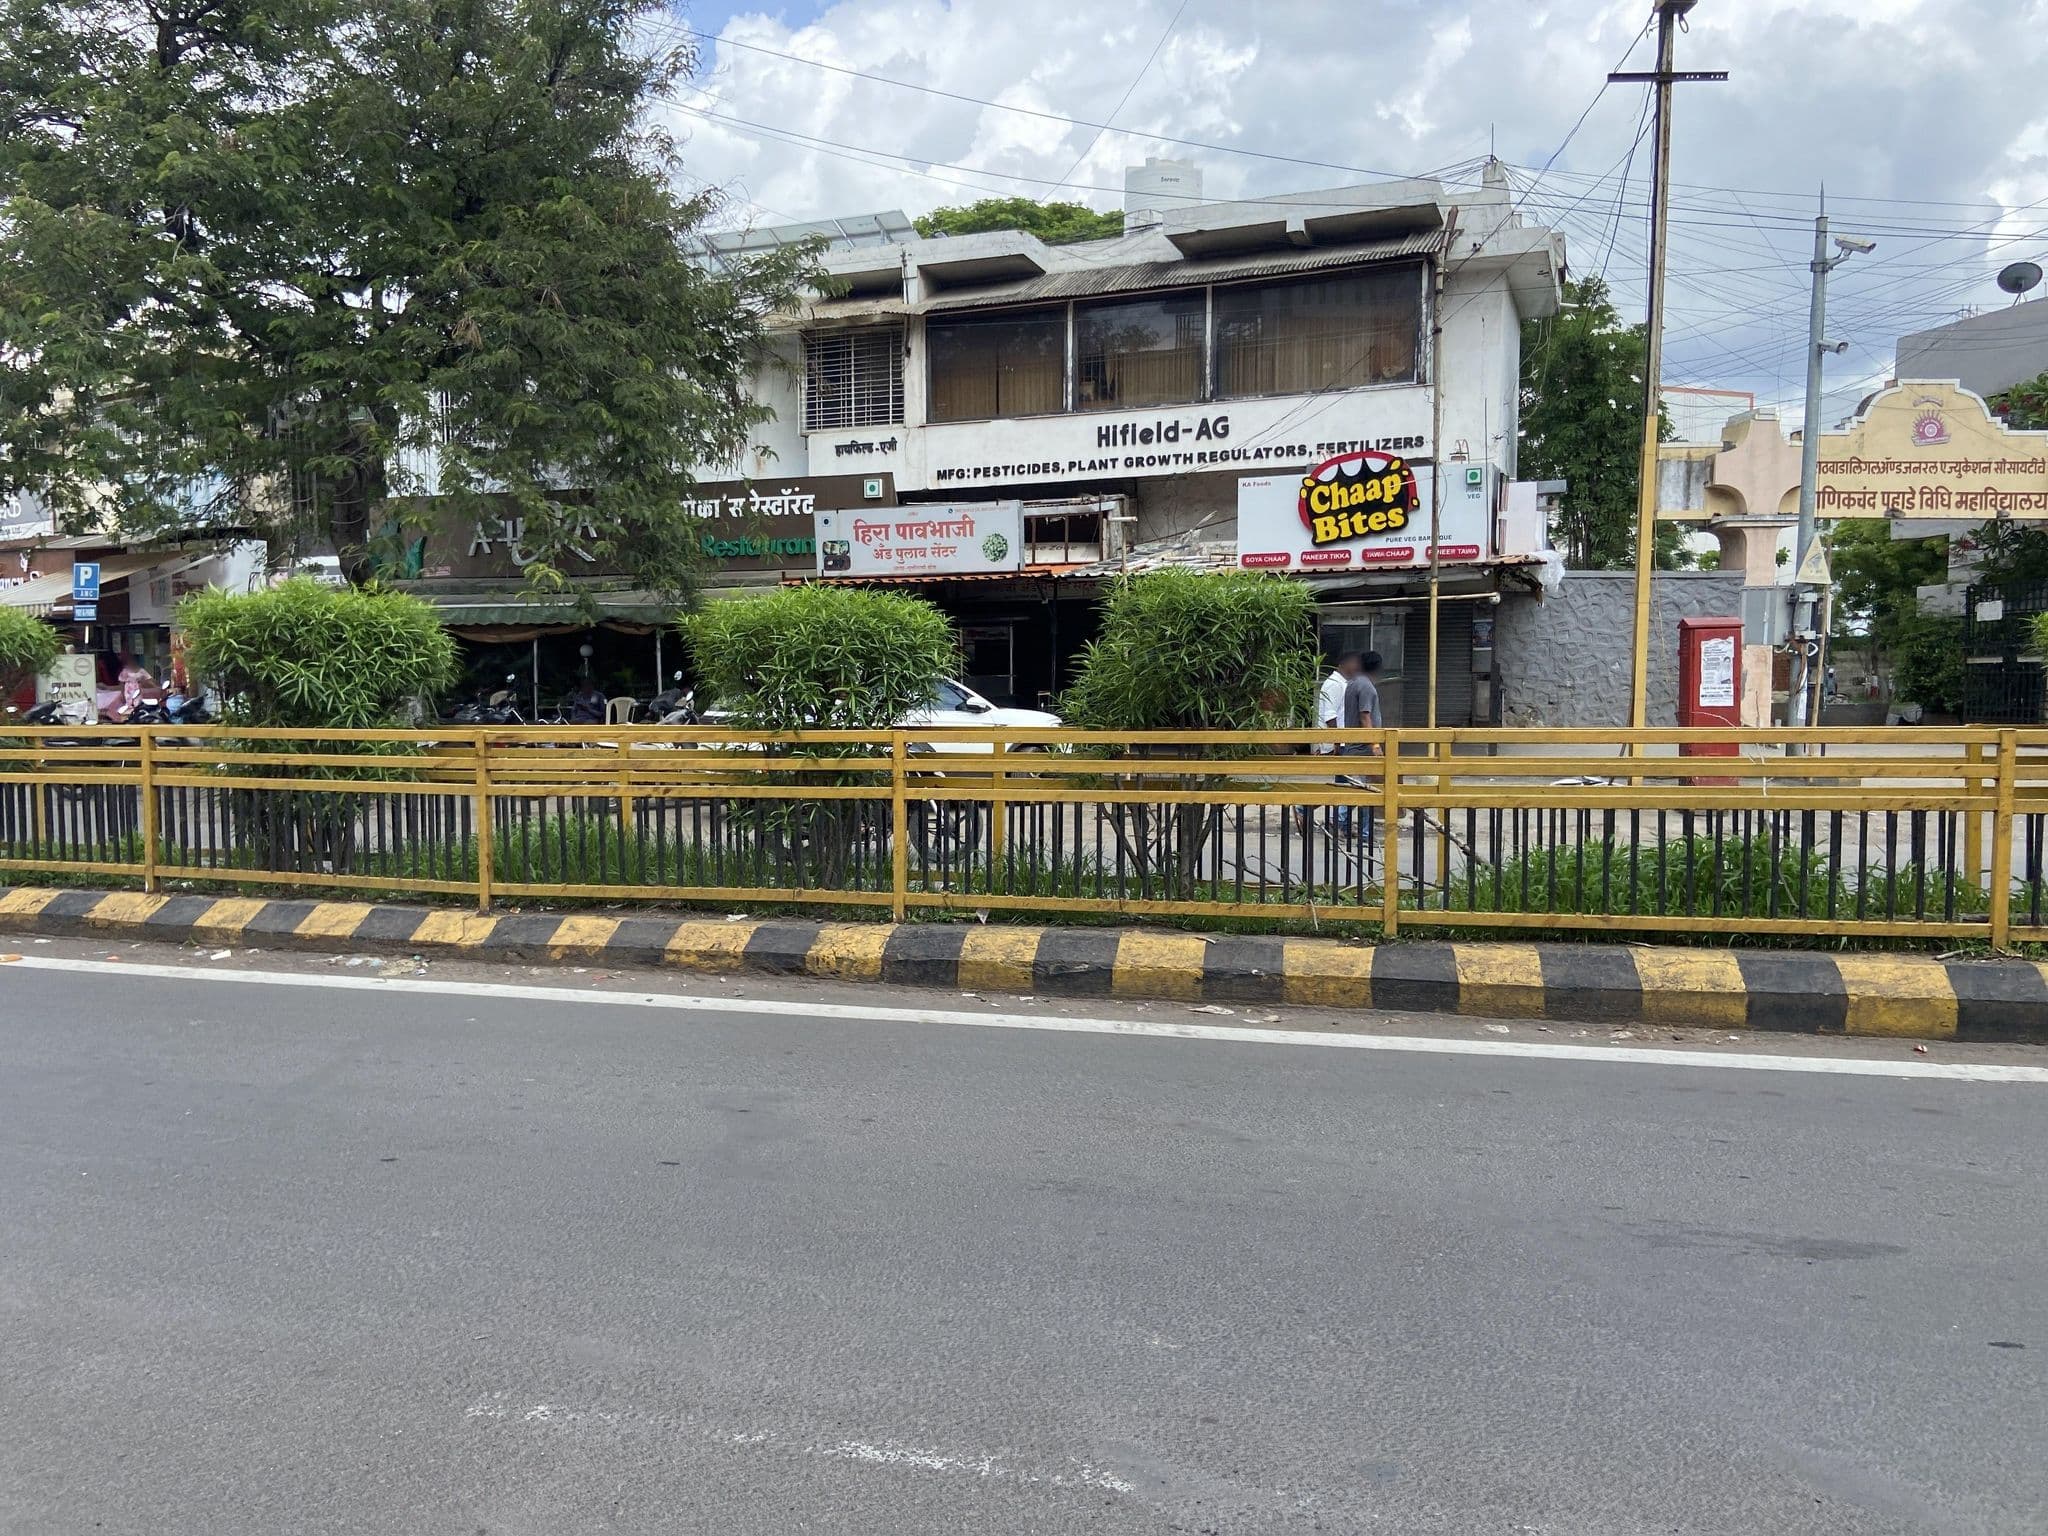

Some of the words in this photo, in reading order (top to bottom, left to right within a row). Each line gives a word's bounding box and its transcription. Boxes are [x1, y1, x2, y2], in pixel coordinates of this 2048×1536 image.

[1097, 415, 1230, 448] Hifield-AG
[973, 461, 1065, 478] PESTICIDES,
[1068, 457, 1119, 472] PLANT
[1124, 451, 1193, 469] GROWTH
[1197, 443, 1313, 465] REGULATORS,
[1316, 435, 1425, 456] FERTILIZERS
[1903, 461, 1938, 475] जनरल
[1310, 473, 1402, 514] Chaap
[1919, 486, 1953, 510] विधि
[853, 518, 891, 546] हिरा
[895, 514, 976, 541] पावभाजी
[1312, 507, 1405, 543] Bites
[896, 546, 928, 564] पुलाव
[931, 542, 958, 559] सेंटर
[1302, 553, 1328, 561] PANEER
[1329, 552, 1350, 560] TIKKA
[80, 566, 92, 586] P
